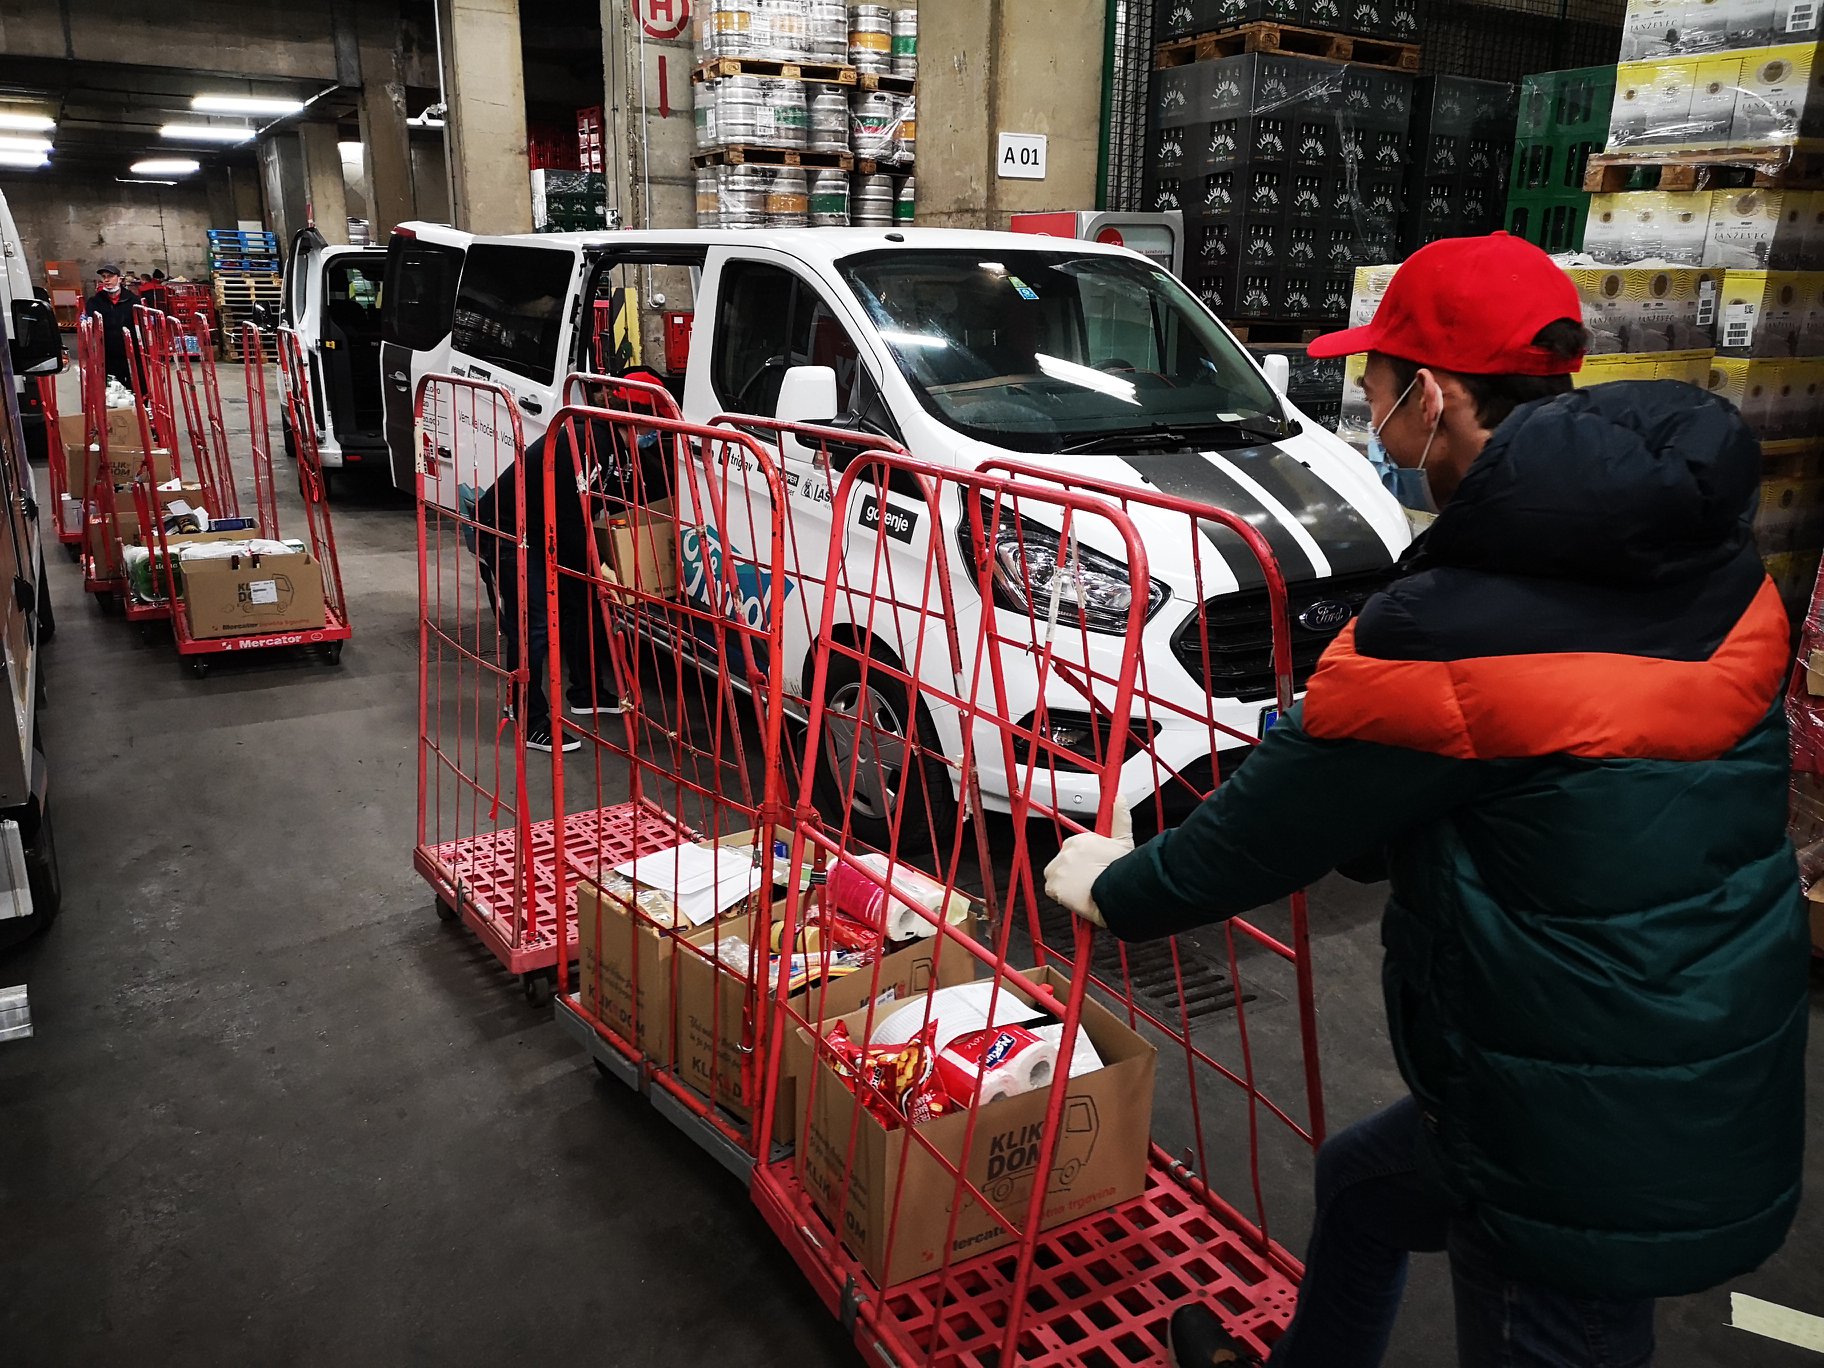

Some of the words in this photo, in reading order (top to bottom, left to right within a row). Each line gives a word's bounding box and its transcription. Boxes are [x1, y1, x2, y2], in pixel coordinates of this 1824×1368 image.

[1004, 146, 1016, 164] A
[1020, 148, 1040, 166] 01
[730, 453, 753, 472] trigav
[866, 504, 909, 532] goenje
[1316, 604, 1344, 624] Ford
[239, 635, 302, 650] Mercator
